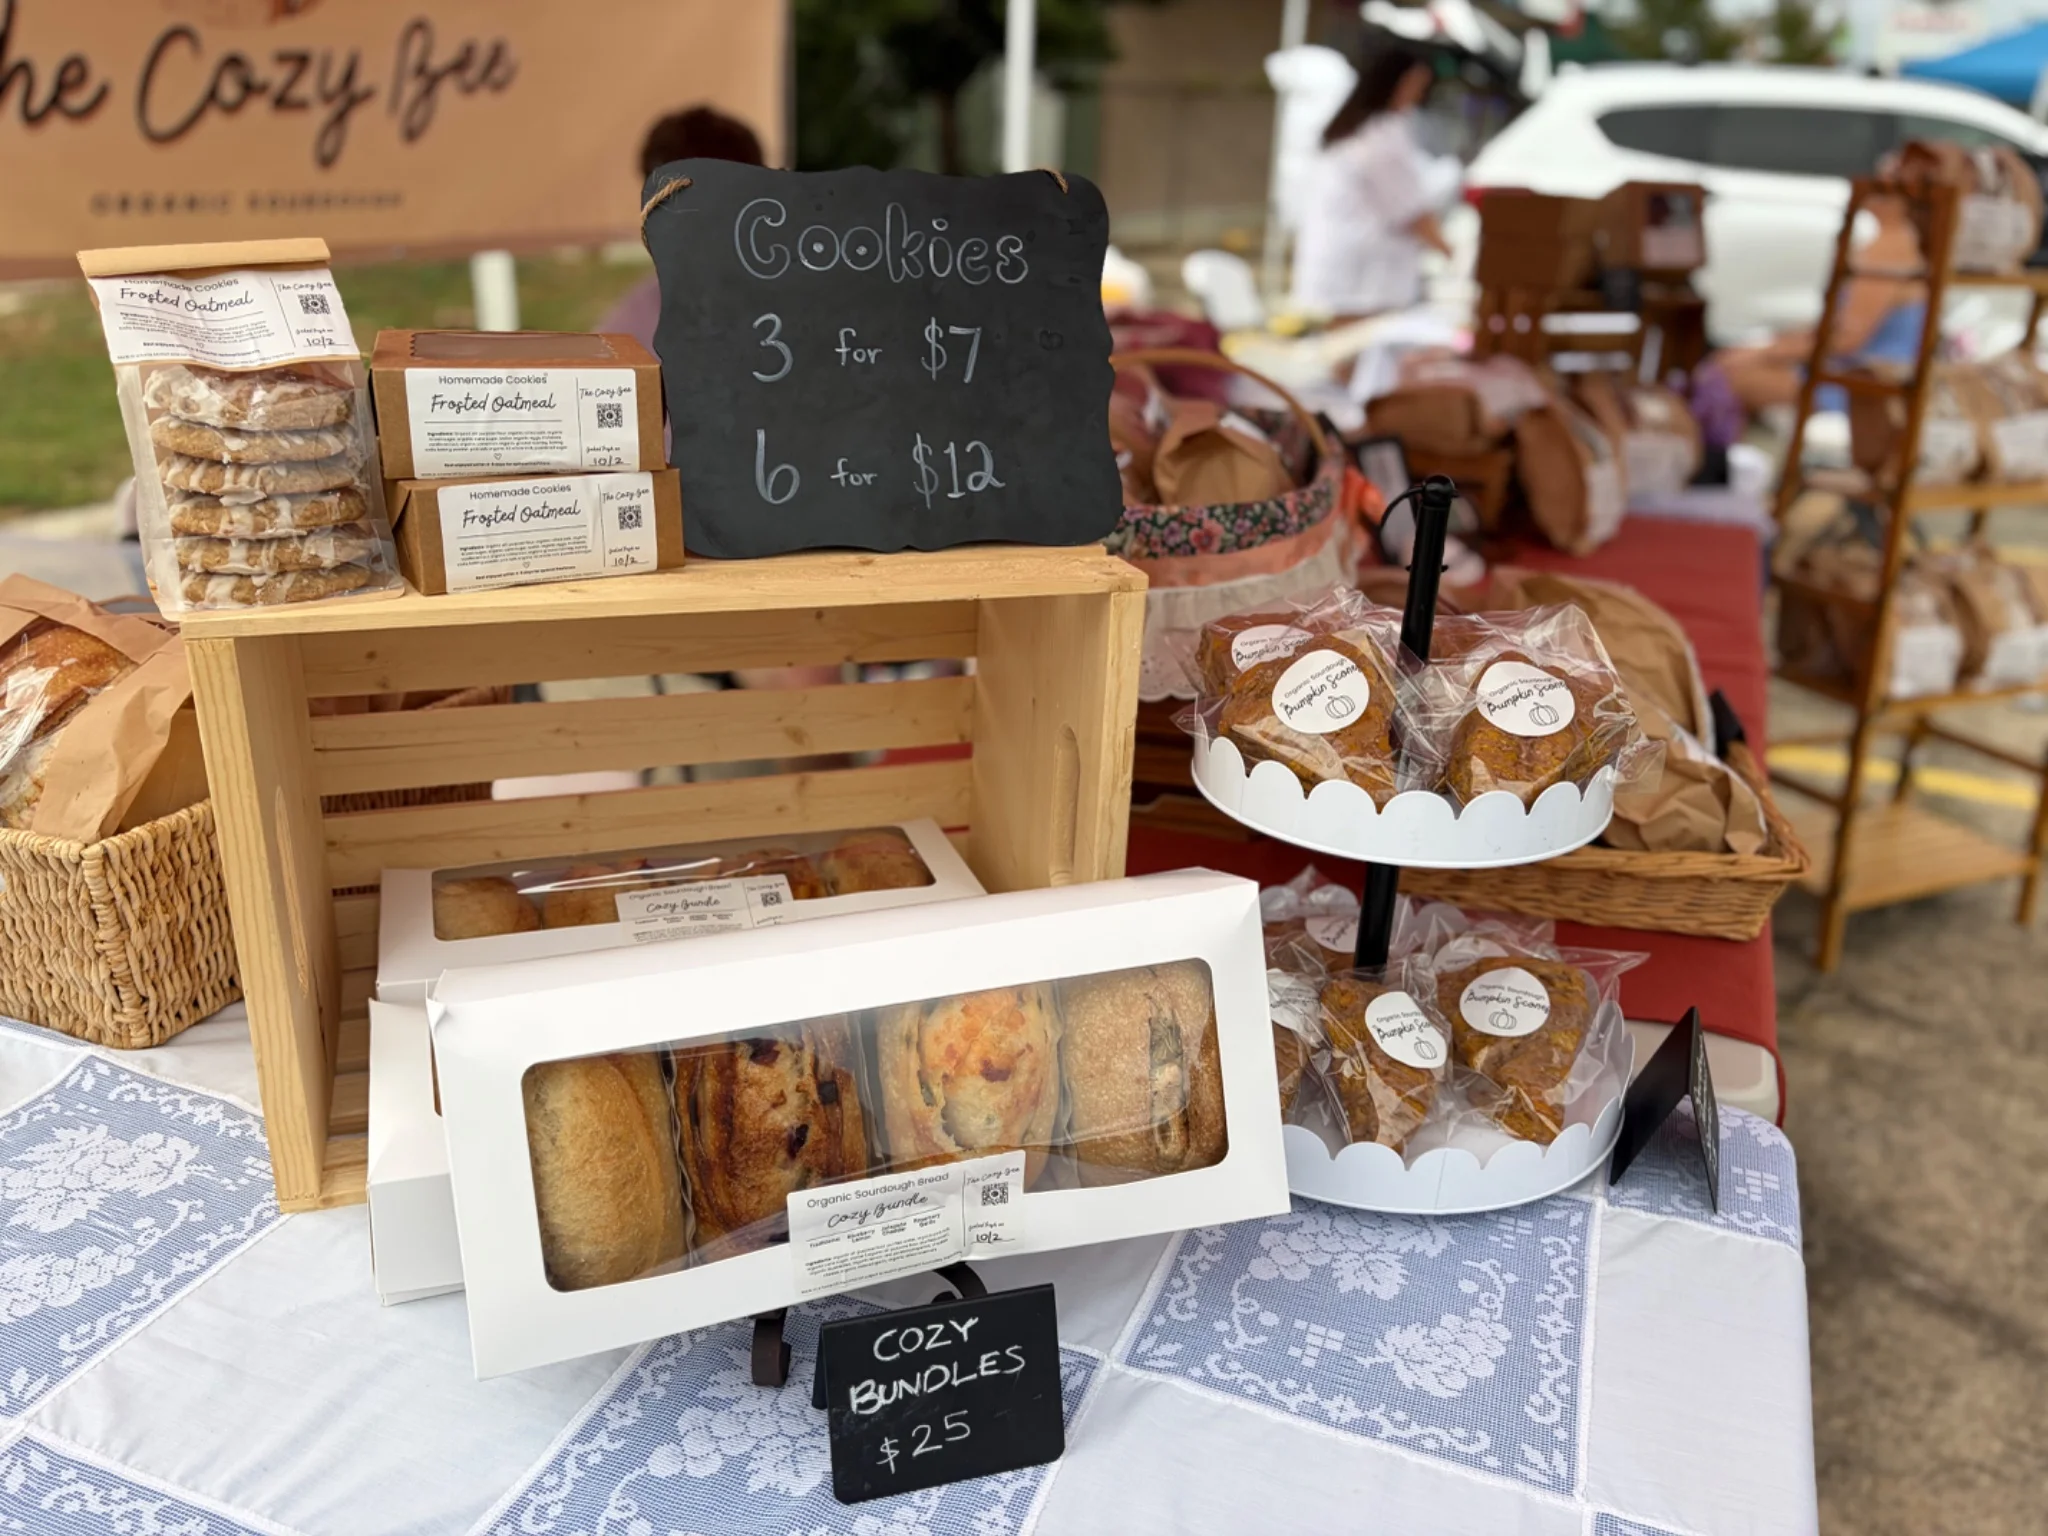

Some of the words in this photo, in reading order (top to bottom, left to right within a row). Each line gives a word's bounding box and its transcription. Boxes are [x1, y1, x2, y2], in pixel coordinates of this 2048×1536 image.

[0, 0, 111, 128] he
[134, 22, 377, 172] Cozy
[387, 15, 519, 144] Bee
[734, 198, 1030, 286] Cookies
[194, 278, 239, 292] Cookies
[120, 287, 180, 308] Frosted
[184, 290, 254, 312] Oatmeal
[752, 312, 795, 383] 3
[834, 327, 883, 367] for
[921, 316, 982, 384] $7
[438, 374, 503, 386] Homemade
[506, 374, 547, 386] Cookies
[431, 392, 487, 414] Frosted
[491, 391, 556, 413] Oatmeal
[593, 455, 624, 467] 10/2
[755, 429, 800, 505] 6
[830, 457, 878, 489] for
[911, 432, 1006, 510] $12
[469, 485, 530, 500] Homemade
[532, 483, 572, 495] Cookies
[462, 505, 517, 529] Frosted
[520, 499, 581, 525] Oatmeal
[1284, 678, 1311, 698] Organic
[1310, 658, 1347, 680] Sourdough
[1489, 680, 1518, 697] Organic
[1279, 684, 1328, 720] Pumpkin
[1482, 688, 1534, 717] Pumpkin
[646, 902, 679, 914] Cozy
[680, 896, 721, 911] Bundle
[1464, 989, 1511, 1005] Pumpkin
[1507, 986, 1545, 1001] Sourdough
[1376, 1013, 1402, 1023] Organic
[1372, 1021, 1416, 1043] Pumpkin
[807, 1192, 852, 1208] Organic
[855, 1180, 916, 1200] Sourdough
[918, 1172, 950, 1185] Bread
[827, 1208, 871, 1228] Cozy
[873, 1192, 928, 1218] Bundle
[975, 1231, 1003, 1244] 10/2
[873, 1316, 979, 1362] COZY
[850, 1344, 1026, 1415] BUNDLES
[876, 1410, 971, 1475] $25
